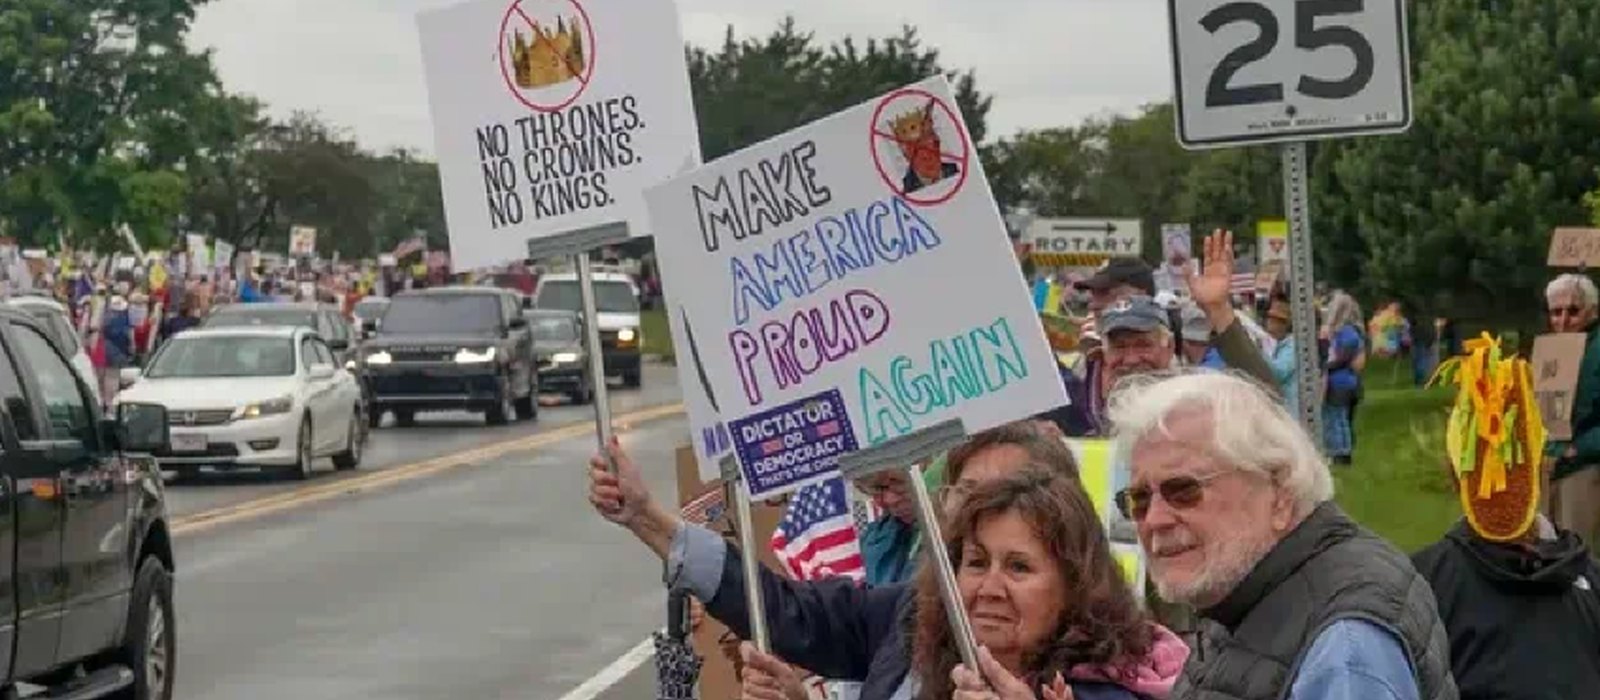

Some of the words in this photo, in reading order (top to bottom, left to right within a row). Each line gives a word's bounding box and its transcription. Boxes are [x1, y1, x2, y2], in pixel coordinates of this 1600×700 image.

[1198, 0, 1374, 107] 25
[476, 124, 509, 161] NO
[515, 96, 646, 151] THRONES.
[482, 158, 516, 195] NO
[524, 132, 642, 184] CROWNS.
[488, 191, 523, 229] NO
[531, 172, 615, 219] KINGS.
[691, 140, 831, 252] MAKE
[728, 195, 941, 326] AMERICA
[1035, 237, 1136, 251] ROTARY
[728, 289, 890, 406] PROUD
[857, 317, 1029, 445] AGAIN
[741, 400, 834, 443] DICTATOR
[784, 432, 805, 449] OR
[753, 435, 844, 474] DEMOCRACY
